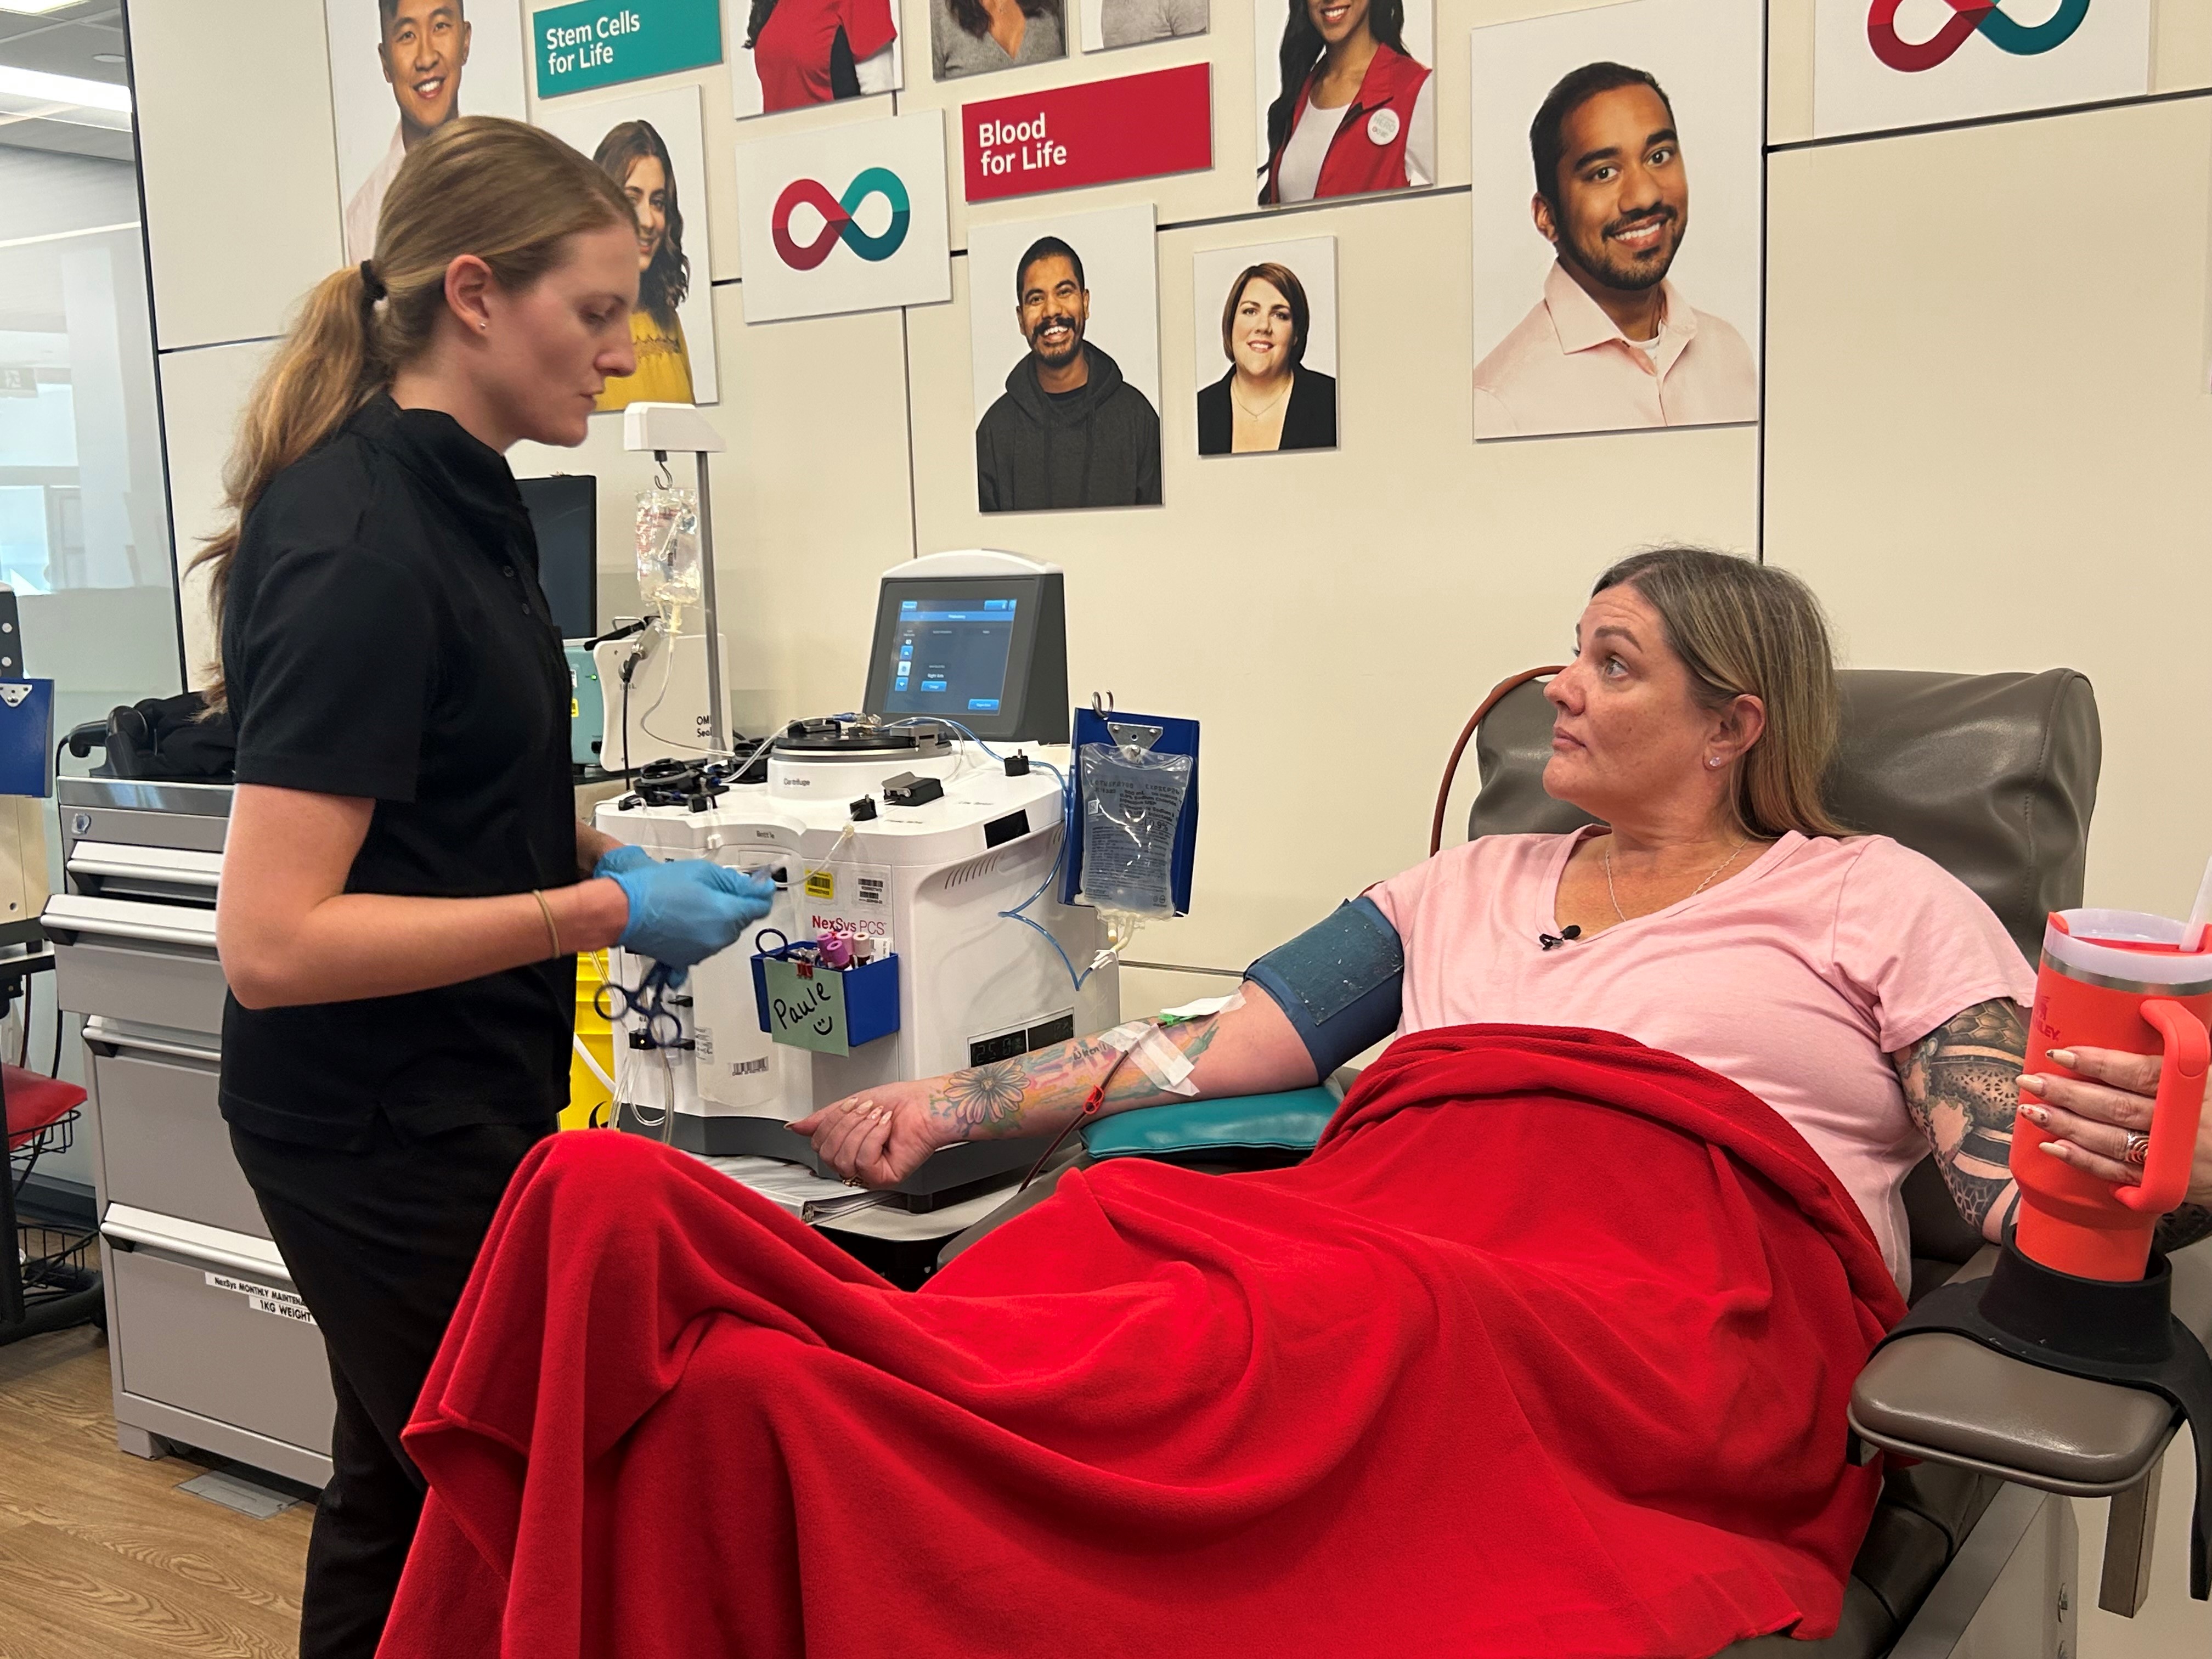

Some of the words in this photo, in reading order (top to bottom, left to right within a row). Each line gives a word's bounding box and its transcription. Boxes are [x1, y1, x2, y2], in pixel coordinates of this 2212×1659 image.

[546, 25, 592, 49] Stem
[596, 10, 640, 38] Cells
[548, 52, 575, 75] for
[579, 42, 613, 69] Life
[979, 112, 1046, 148] Blood
[981, 150, 1015, 176] for
[1022, 140, 1067, 170] Life
[774, 982, 831, 1030] Paule
[239, 1283, 268, 1297] MONTHLY
[260, 1300, 276, 1312] 1KG
[279, 1304, 311, 1322] WEIGHT
